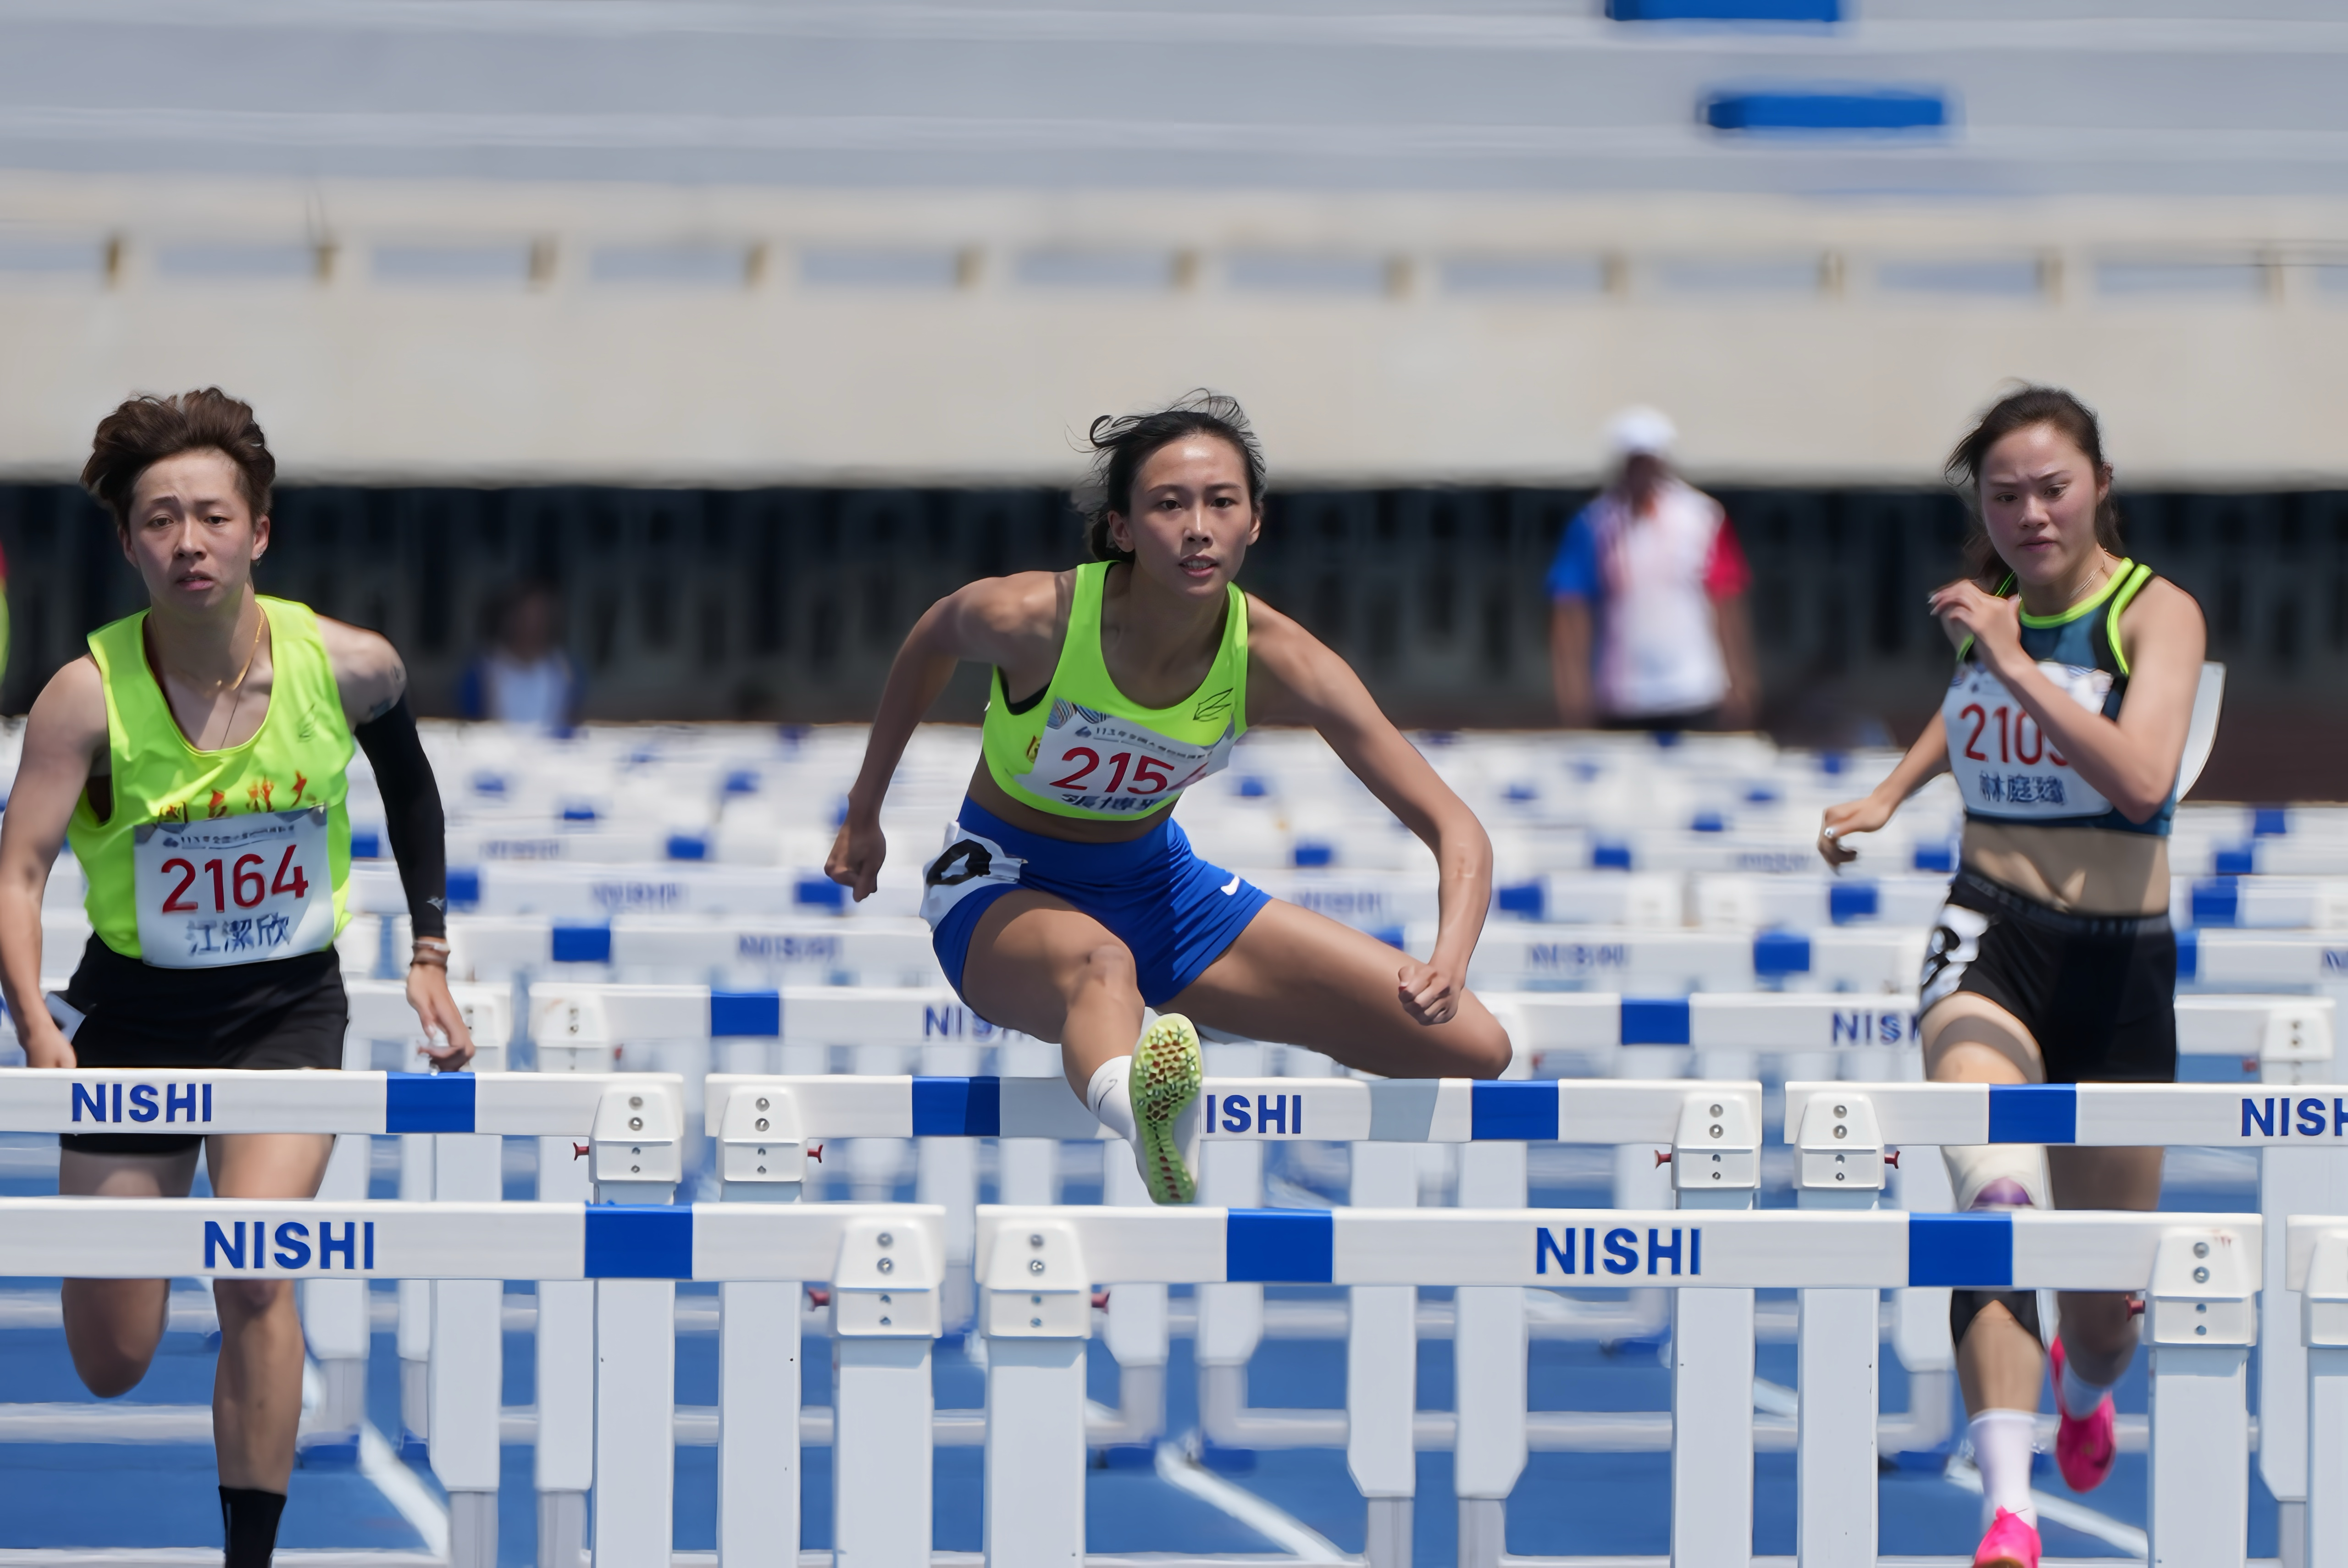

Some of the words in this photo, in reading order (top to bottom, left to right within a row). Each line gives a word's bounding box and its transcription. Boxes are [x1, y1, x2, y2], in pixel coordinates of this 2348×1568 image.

[162, 845, 308, 913] 2164
[72, 1083, 211, 1122] NISHI
[1201, 1094, 1301, 1134] ISHI
[204, 1221, 374, 1269] NISHI
[1536, 1227, 1701, 1275] NISHI
